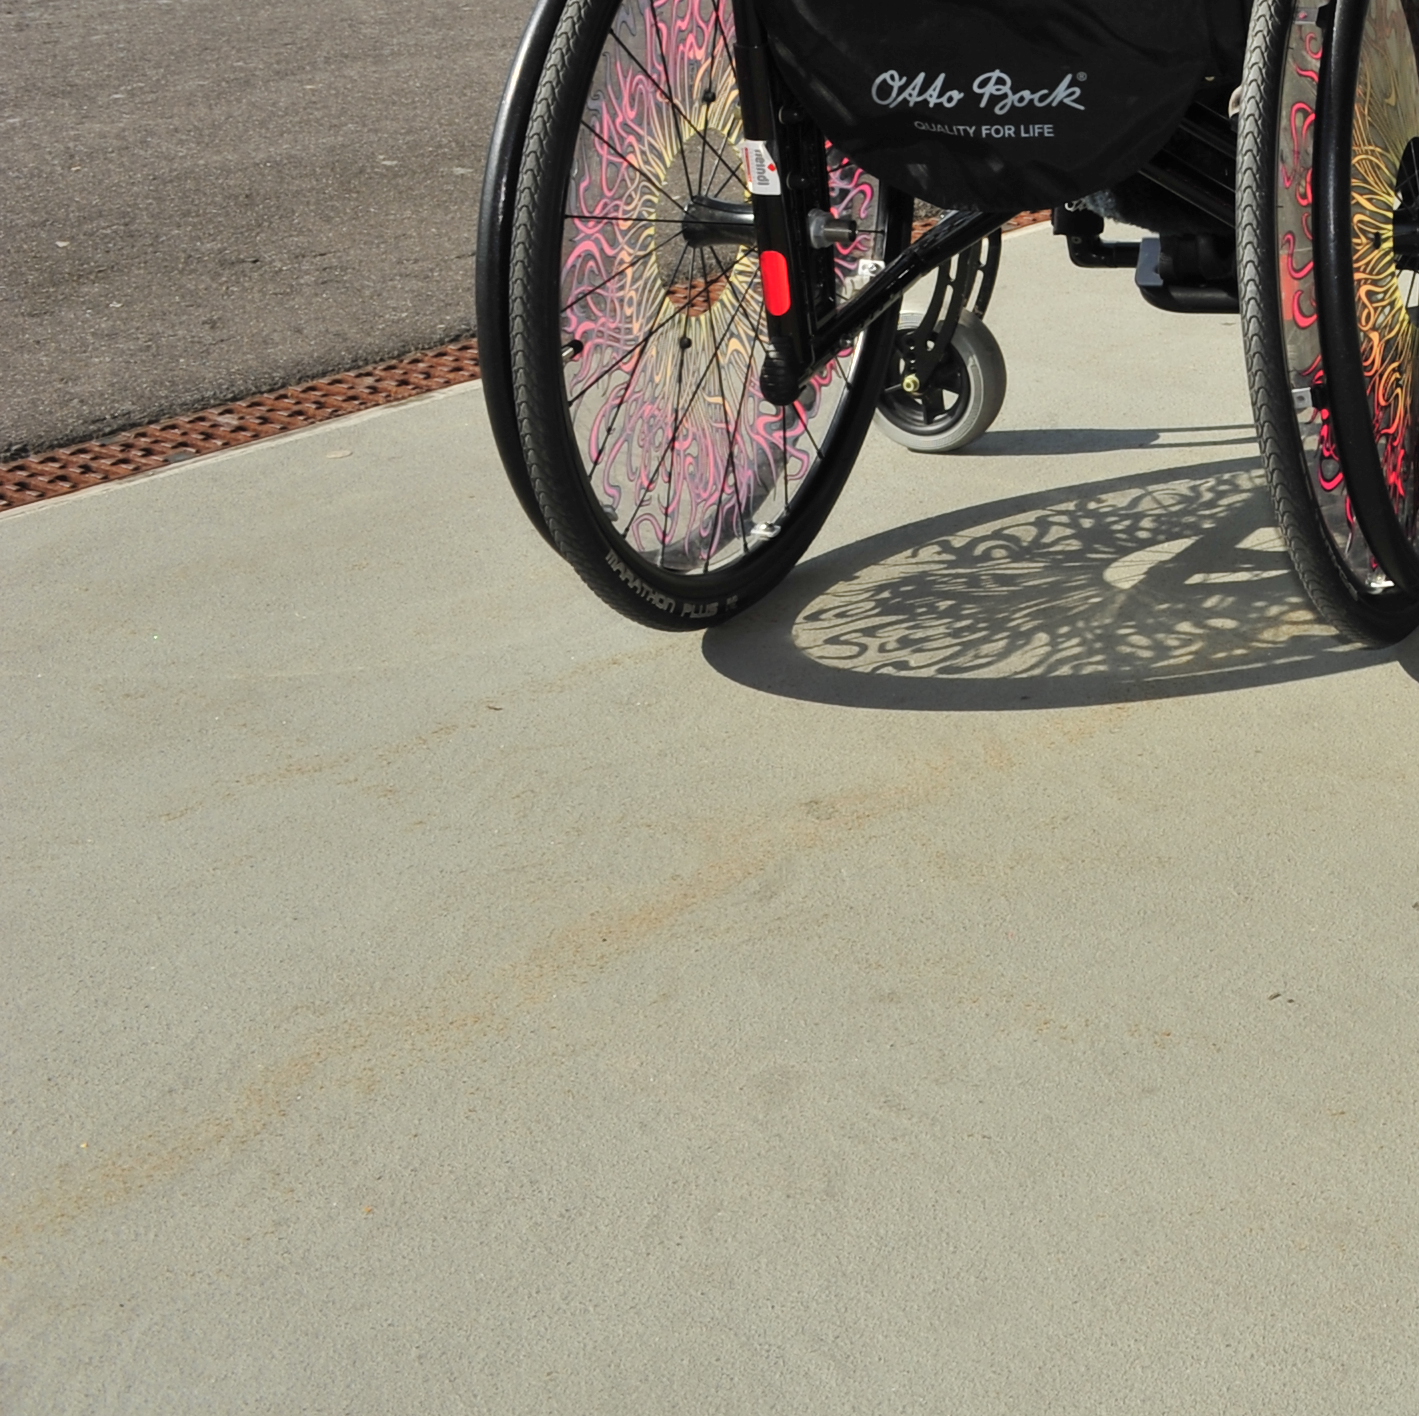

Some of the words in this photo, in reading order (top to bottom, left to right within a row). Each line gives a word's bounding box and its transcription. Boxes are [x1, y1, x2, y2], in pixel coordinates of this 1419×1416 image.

[871, 70, 965, 108] Otto
[914, 120, 976, 138] QUALITY
[981, 124, 1016, 139] FOR
[1020, 124, 1055, 138] LIFE
[605, 549, 676, 614] MARATHON
[680, 602, 719, 619] PLUS
